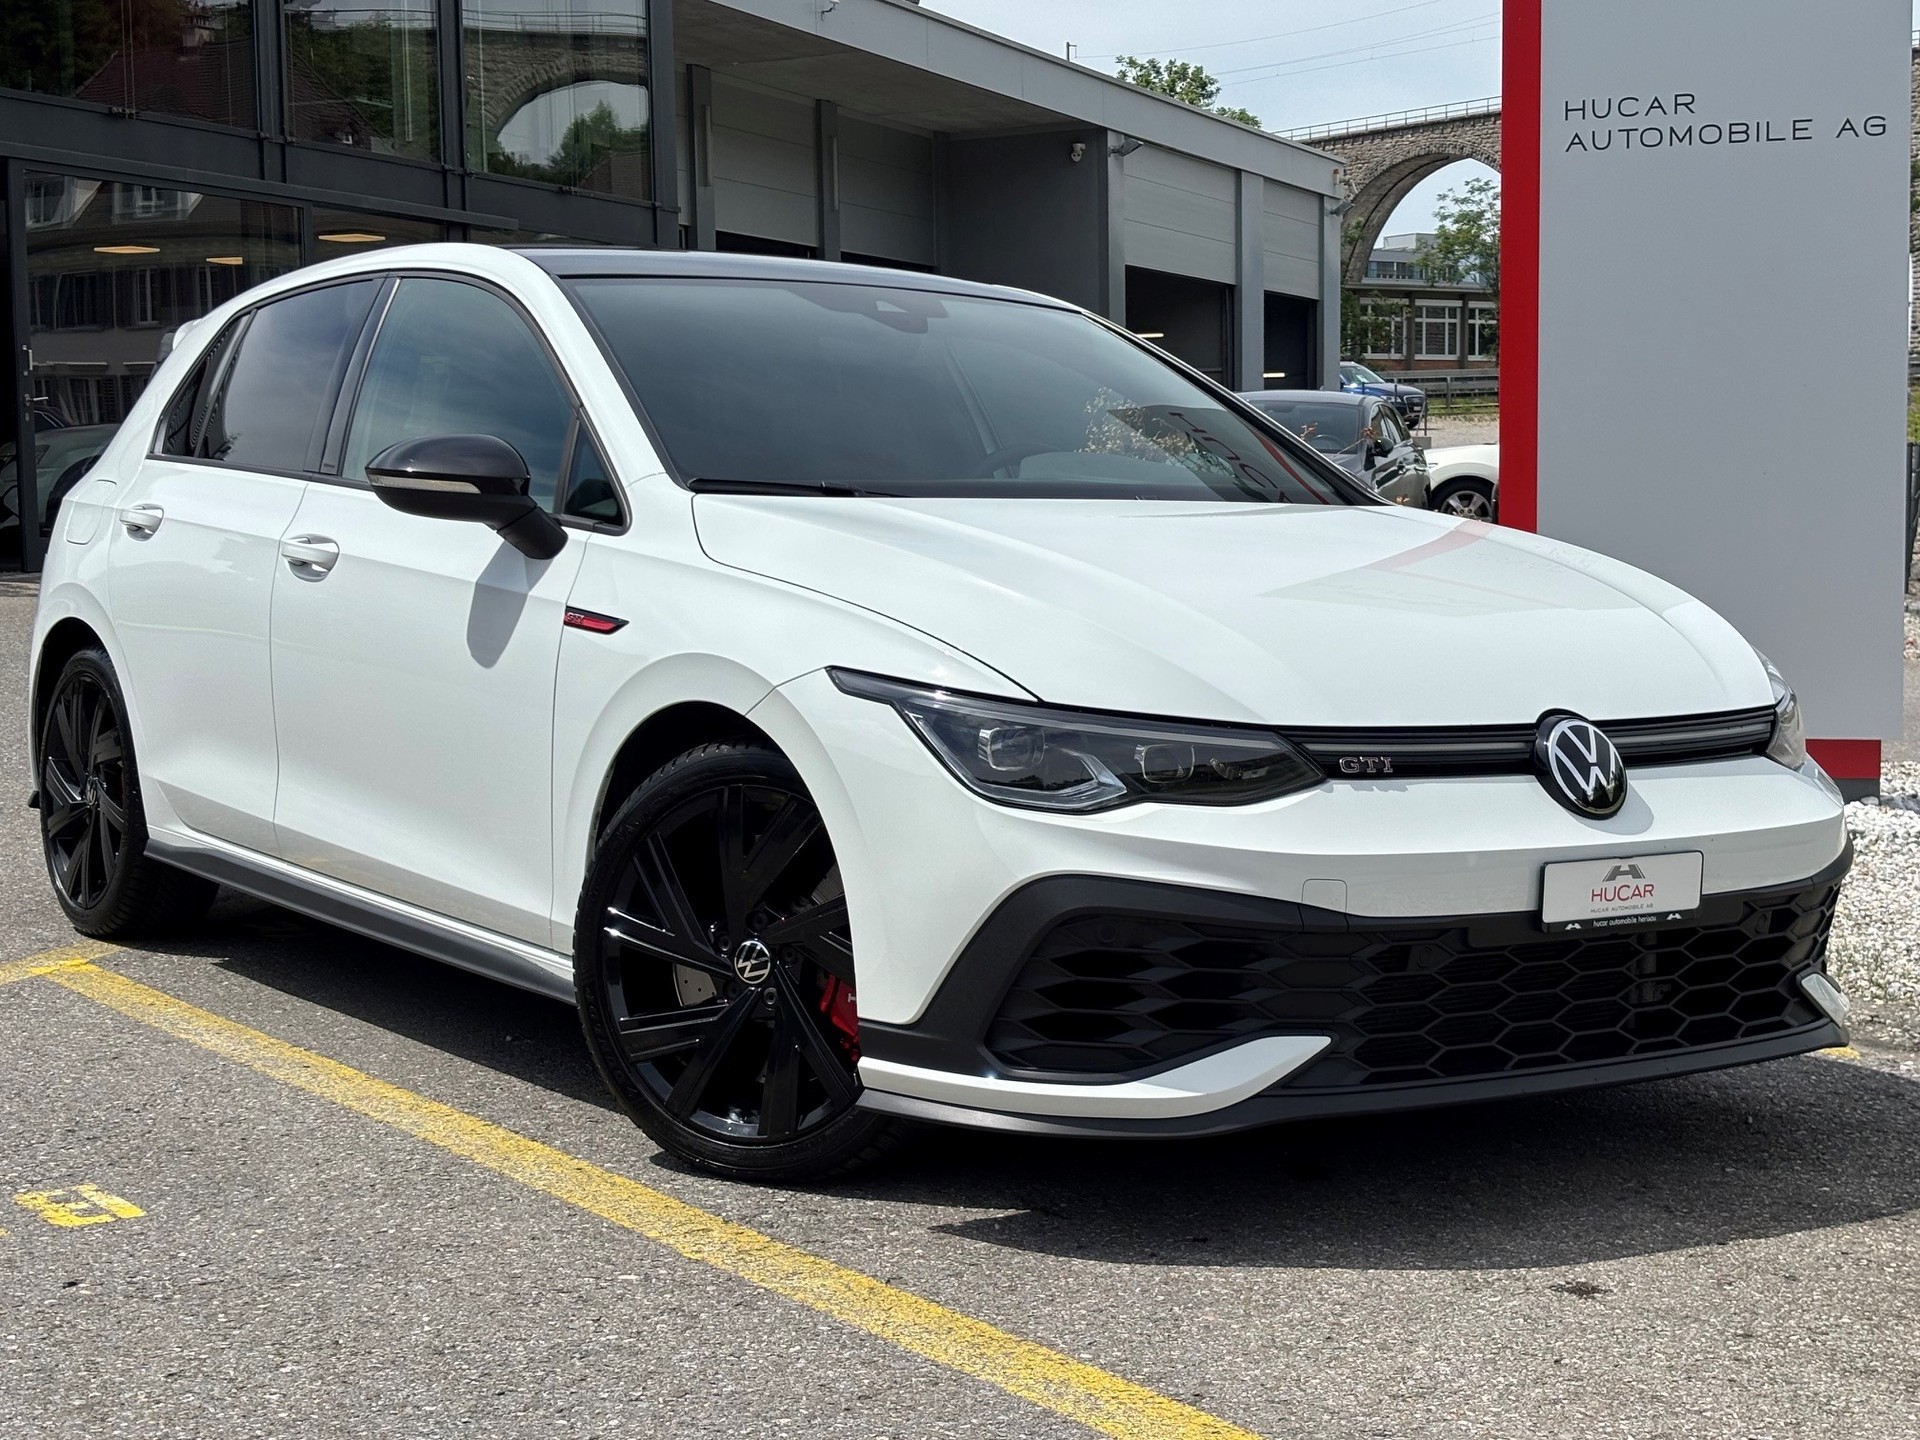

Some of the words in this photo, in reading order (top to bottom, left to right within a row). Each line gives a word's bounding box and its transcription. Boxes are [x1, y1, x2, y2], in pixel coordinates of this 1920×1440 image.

[1565, 93, 1696, 121] HUCAR
[1565, 119, 1813, 152] AUTOMOBILE
[1836, 116, 1887, 138] AG
[1339, 756, 1394, 774] GTI
[1591, 884, 1655, 902] HUCAR
[1609, 916, 1637, 926] automobile
